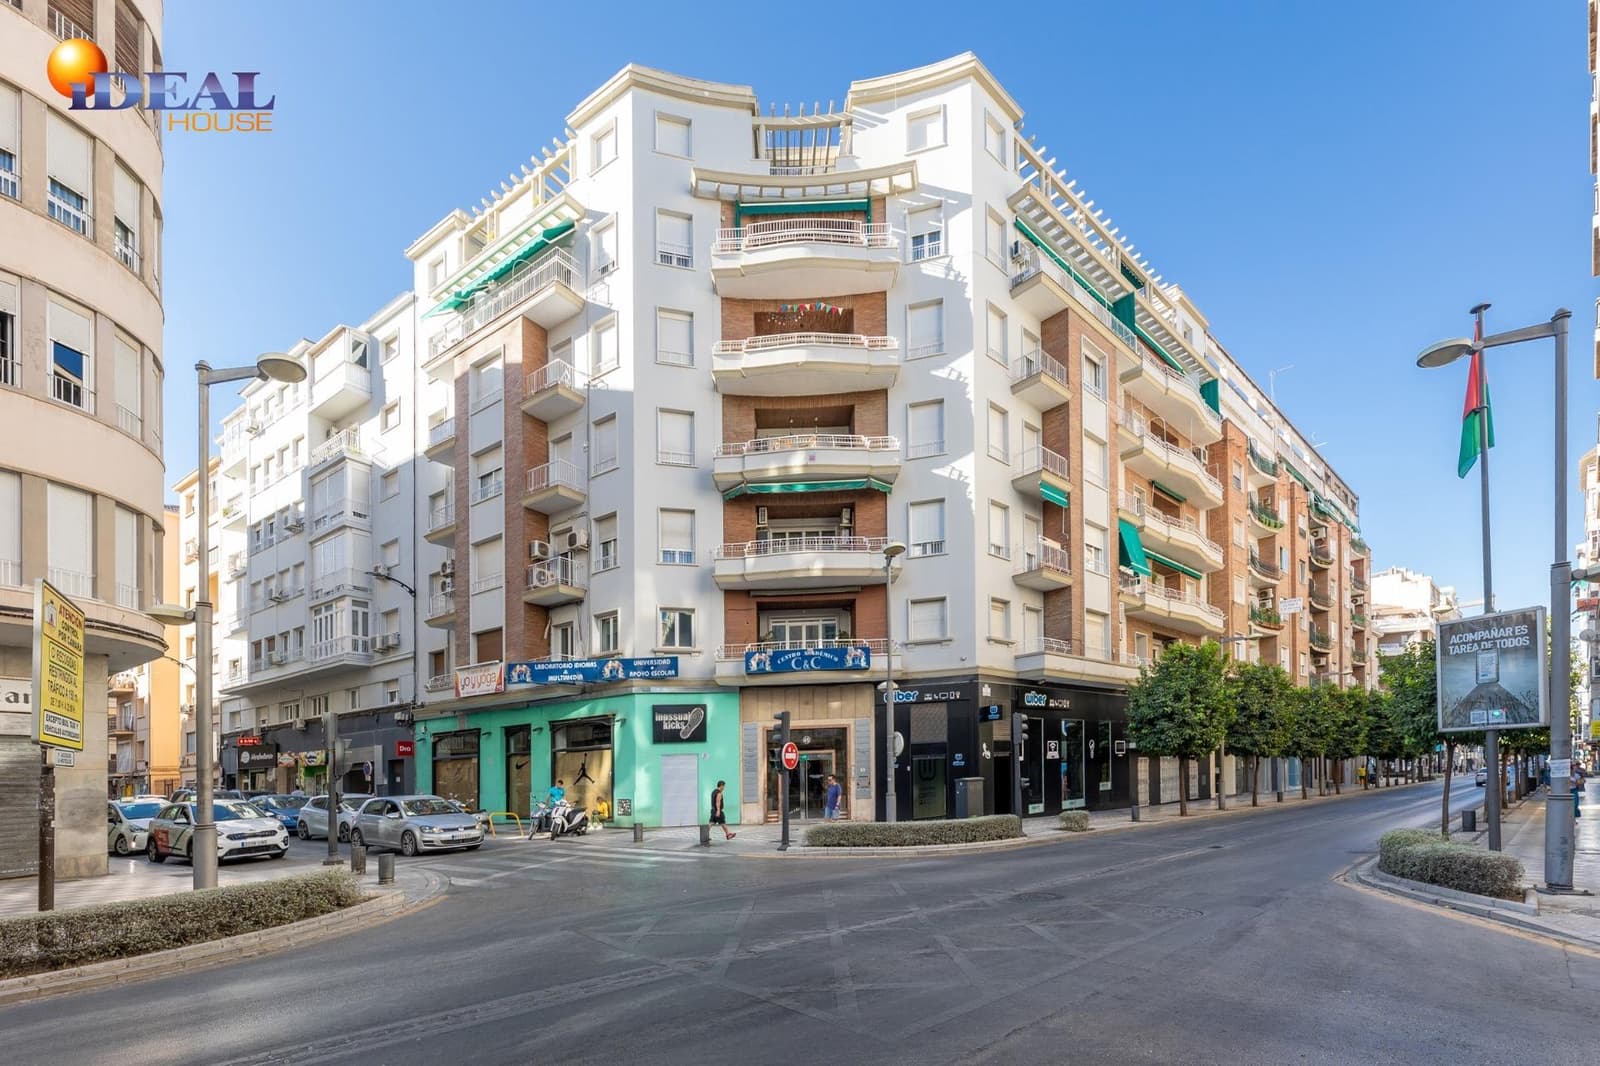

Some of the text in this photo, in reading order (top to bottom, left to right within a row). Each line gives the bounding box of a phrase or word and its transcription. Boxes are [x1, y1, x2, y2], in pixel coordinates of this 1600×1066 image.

[1450, 625, 1528, 645] ACOMPAÑAR ES
[1449, 637, 1530, 655] TAREA DE TODOS
[777, 652, 801, 664] CENTRO
[791, 656, 821, 670] C&C
[1024, 691, 1047, 706] wiber
[663, 720, 685, 729] kicks
